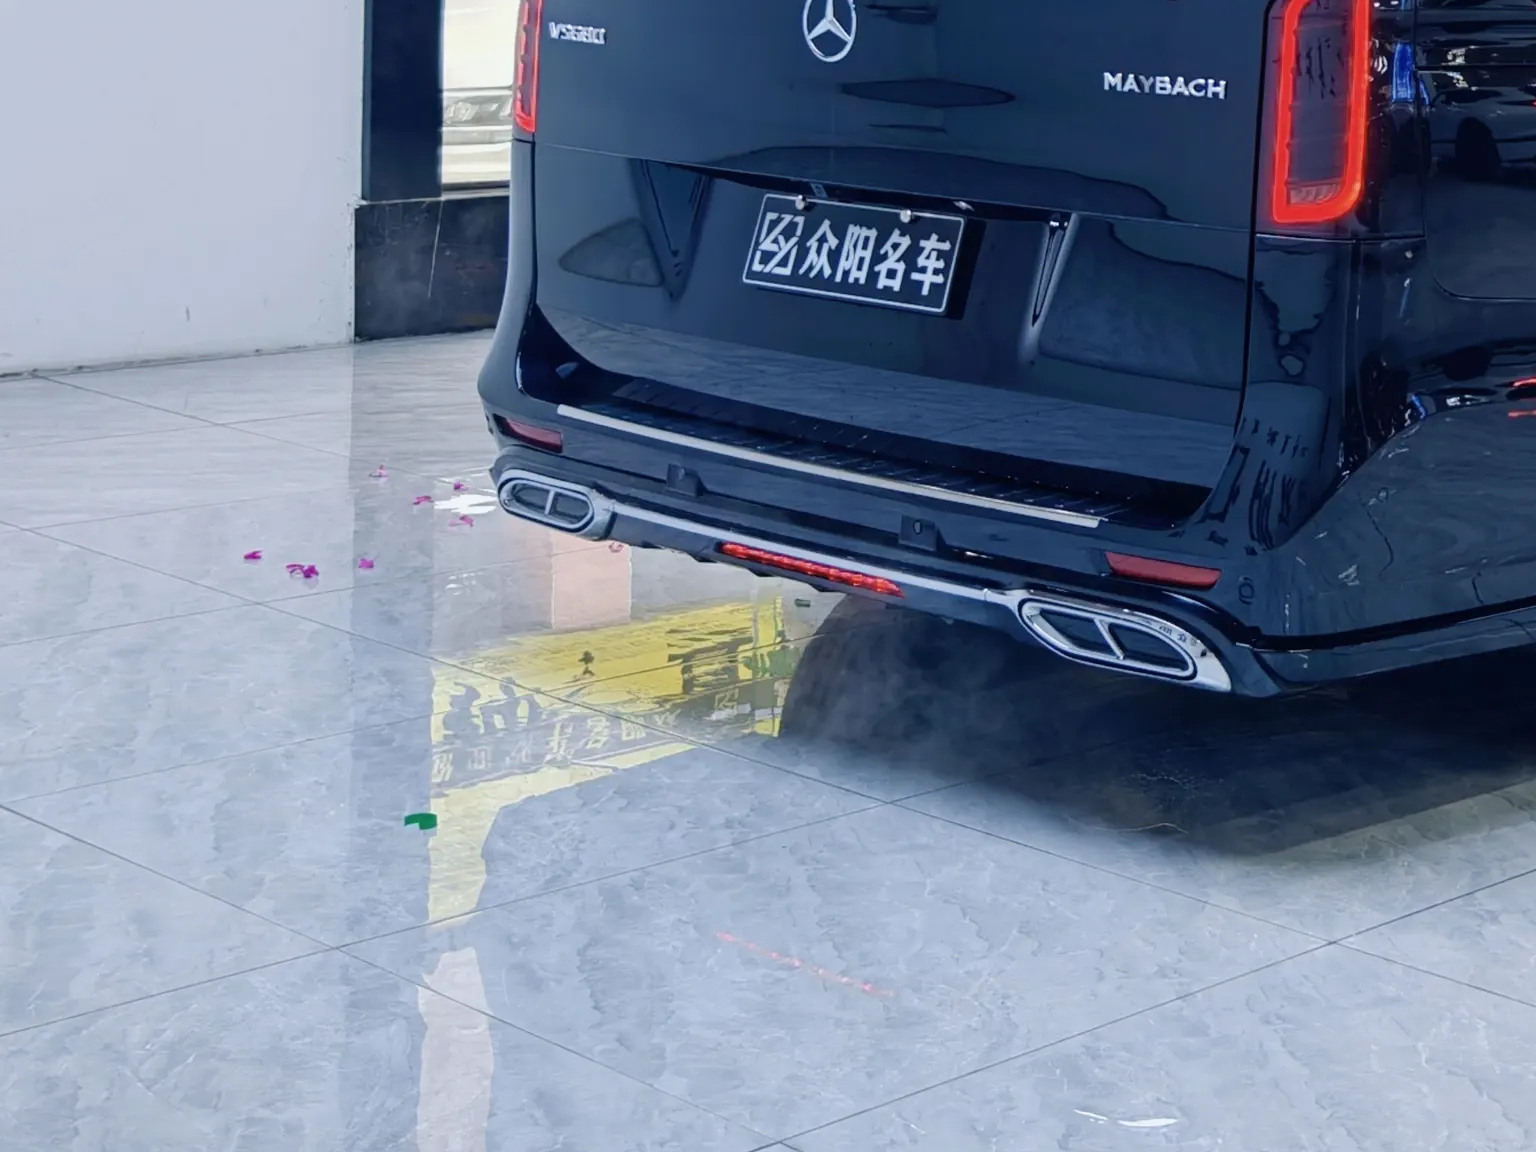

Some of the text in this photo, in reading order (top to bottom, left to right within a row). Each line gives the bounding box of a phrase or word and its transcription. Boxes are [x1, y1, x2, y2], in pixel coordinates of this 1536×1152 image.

[1103, 71, 1227, 100] MAYBACH
[799, 219, 951, 296] 众阳名车
